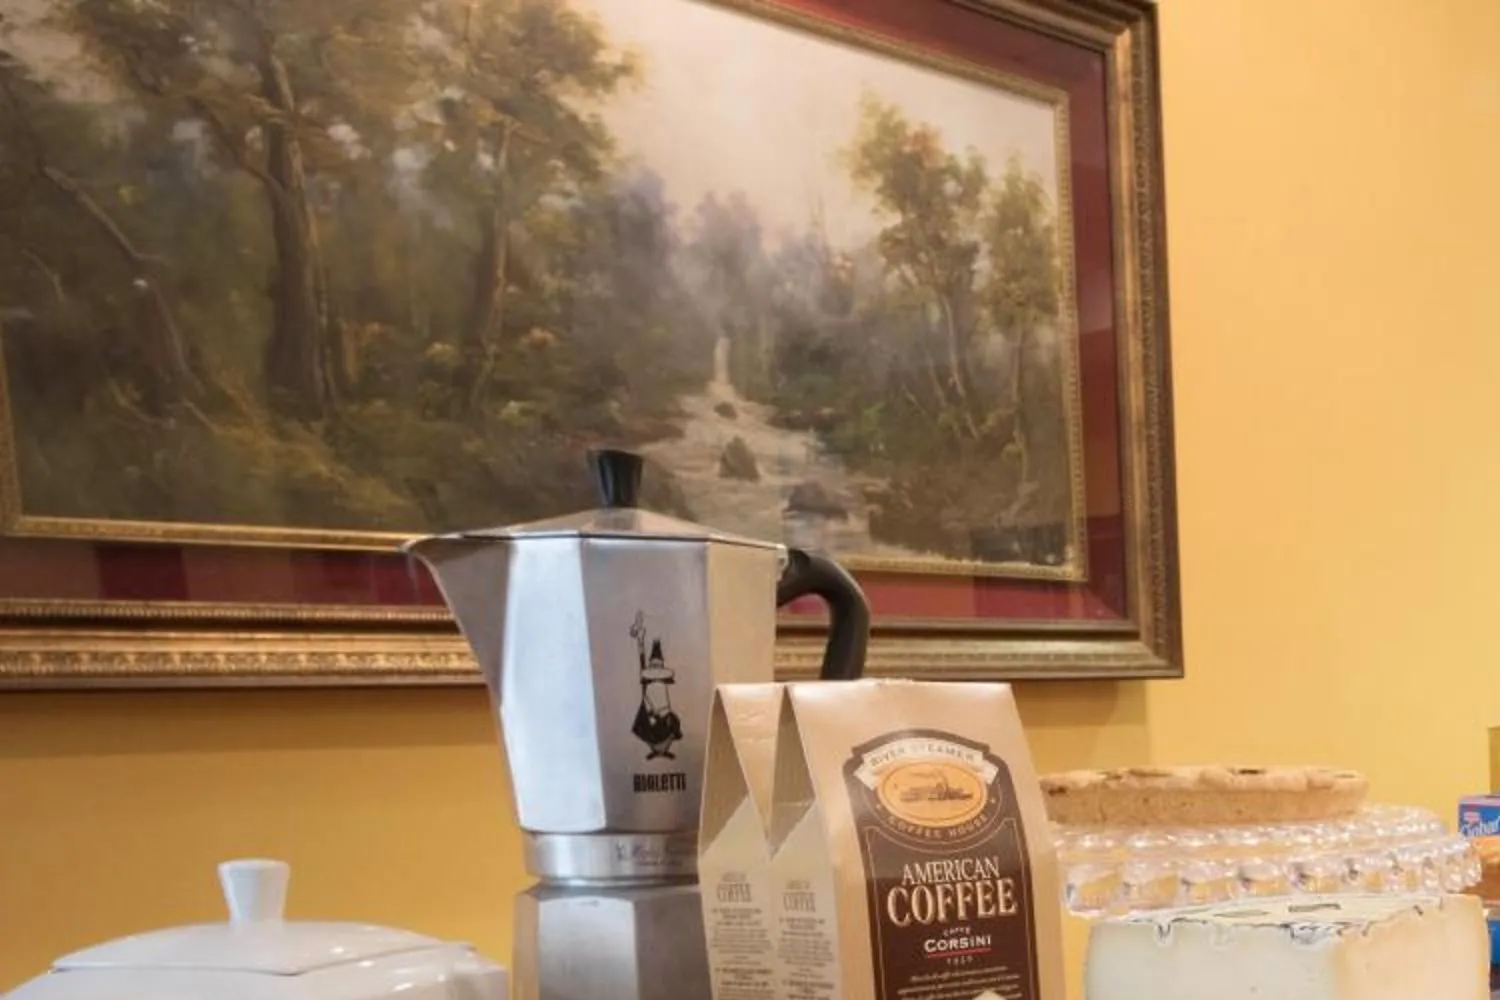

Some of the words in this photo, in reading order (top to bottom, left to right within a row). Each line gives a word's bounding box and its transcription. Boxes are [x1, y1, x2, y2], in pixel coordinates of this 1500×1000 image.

[902, 856, 1000, 886] AMERICAN
[887, 877, 1018, 927] COFFEE
[925, 934, 991, 953] CORSINI
